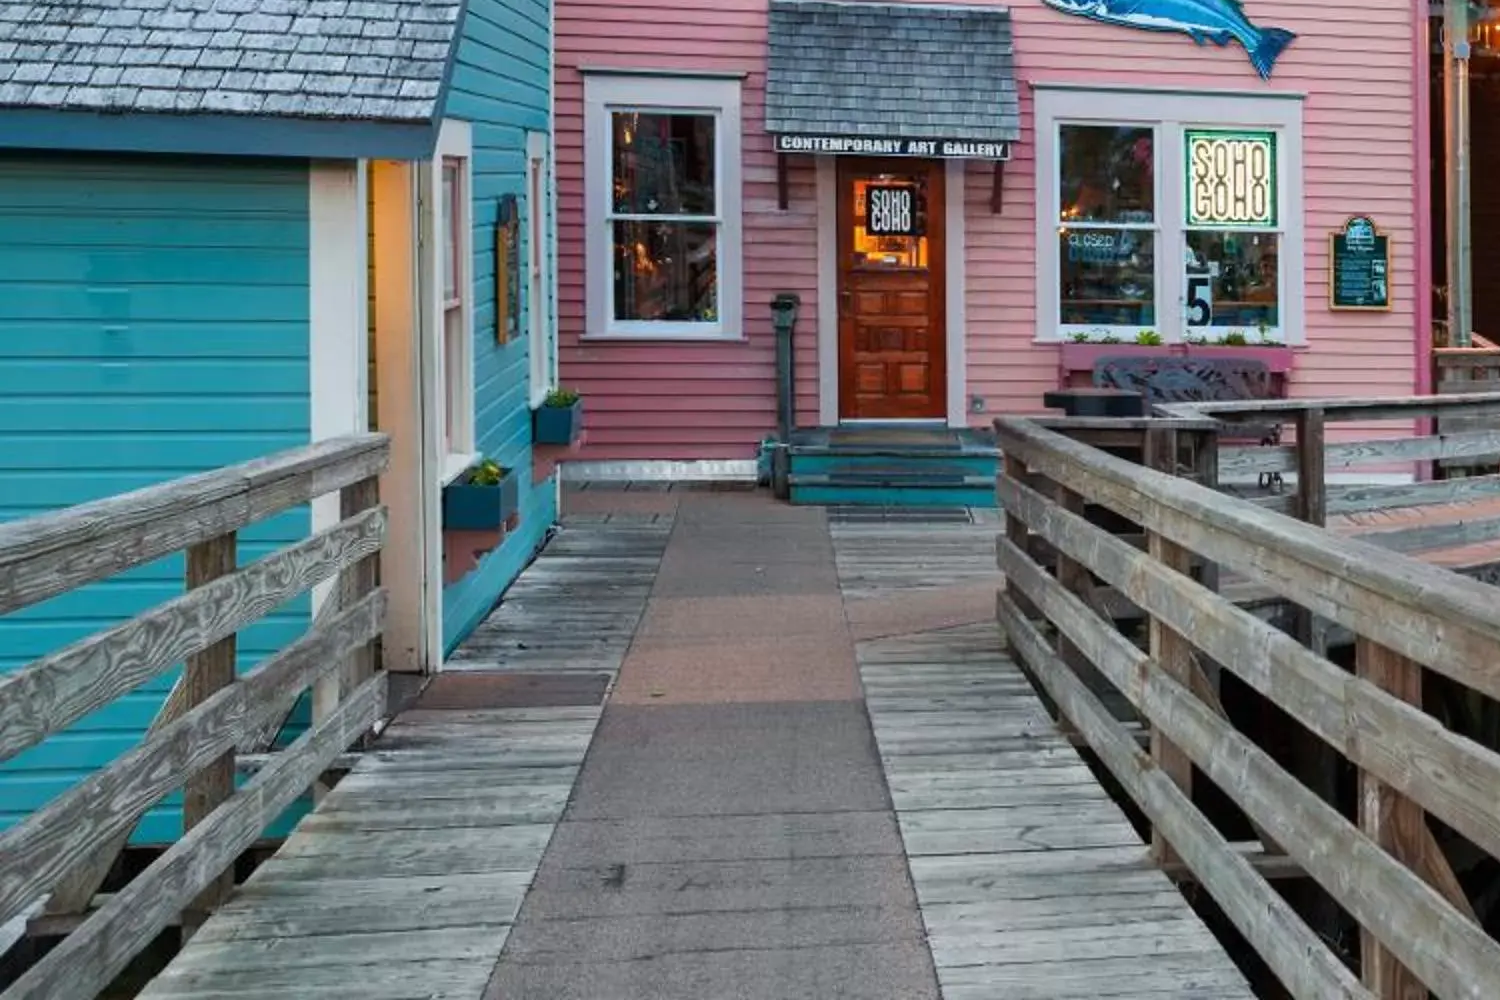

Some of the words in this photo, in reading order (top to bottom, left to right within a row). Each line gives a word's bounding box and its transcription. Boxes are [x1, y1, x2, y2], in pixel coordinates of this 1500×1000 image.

[780, 135, 902, 153] CONTEMPORARY
[907, 140, 937, 154] ART
[943, 141, 1004, 157] GALLERY
[1193, 139, 1267, 181] SOHO
[870, 189, 911, 211] SOHO
[870, 208, 911, 232] COHO
[1187, 277, 1211, 326] 5
